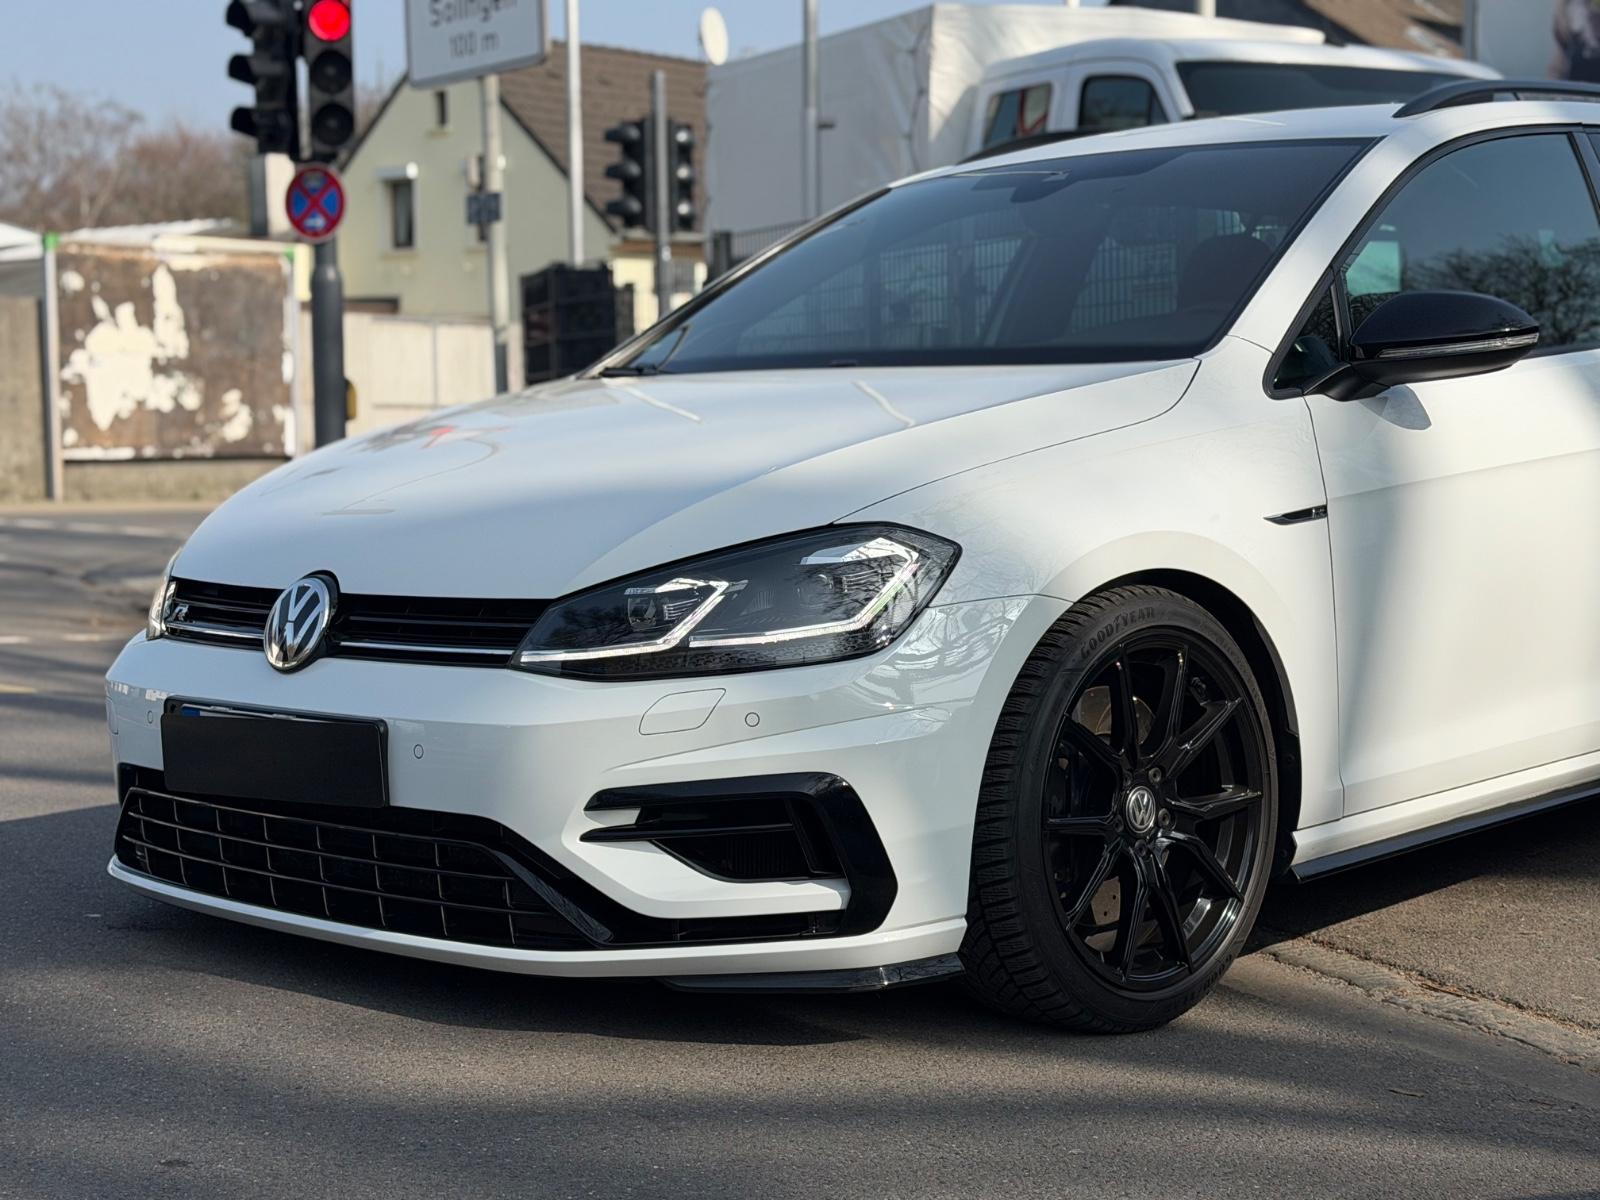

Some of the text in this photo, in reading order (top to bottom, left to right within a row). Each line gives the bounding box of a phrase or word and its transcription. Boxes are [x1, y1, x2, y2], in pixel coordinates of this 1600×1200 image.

[482, 33, 500, 52] m
[266, 577, 330, 669] VW
[1080, 606, 1155, 659] GOODYEAR
[1127, 787, 1155, 832] VW
